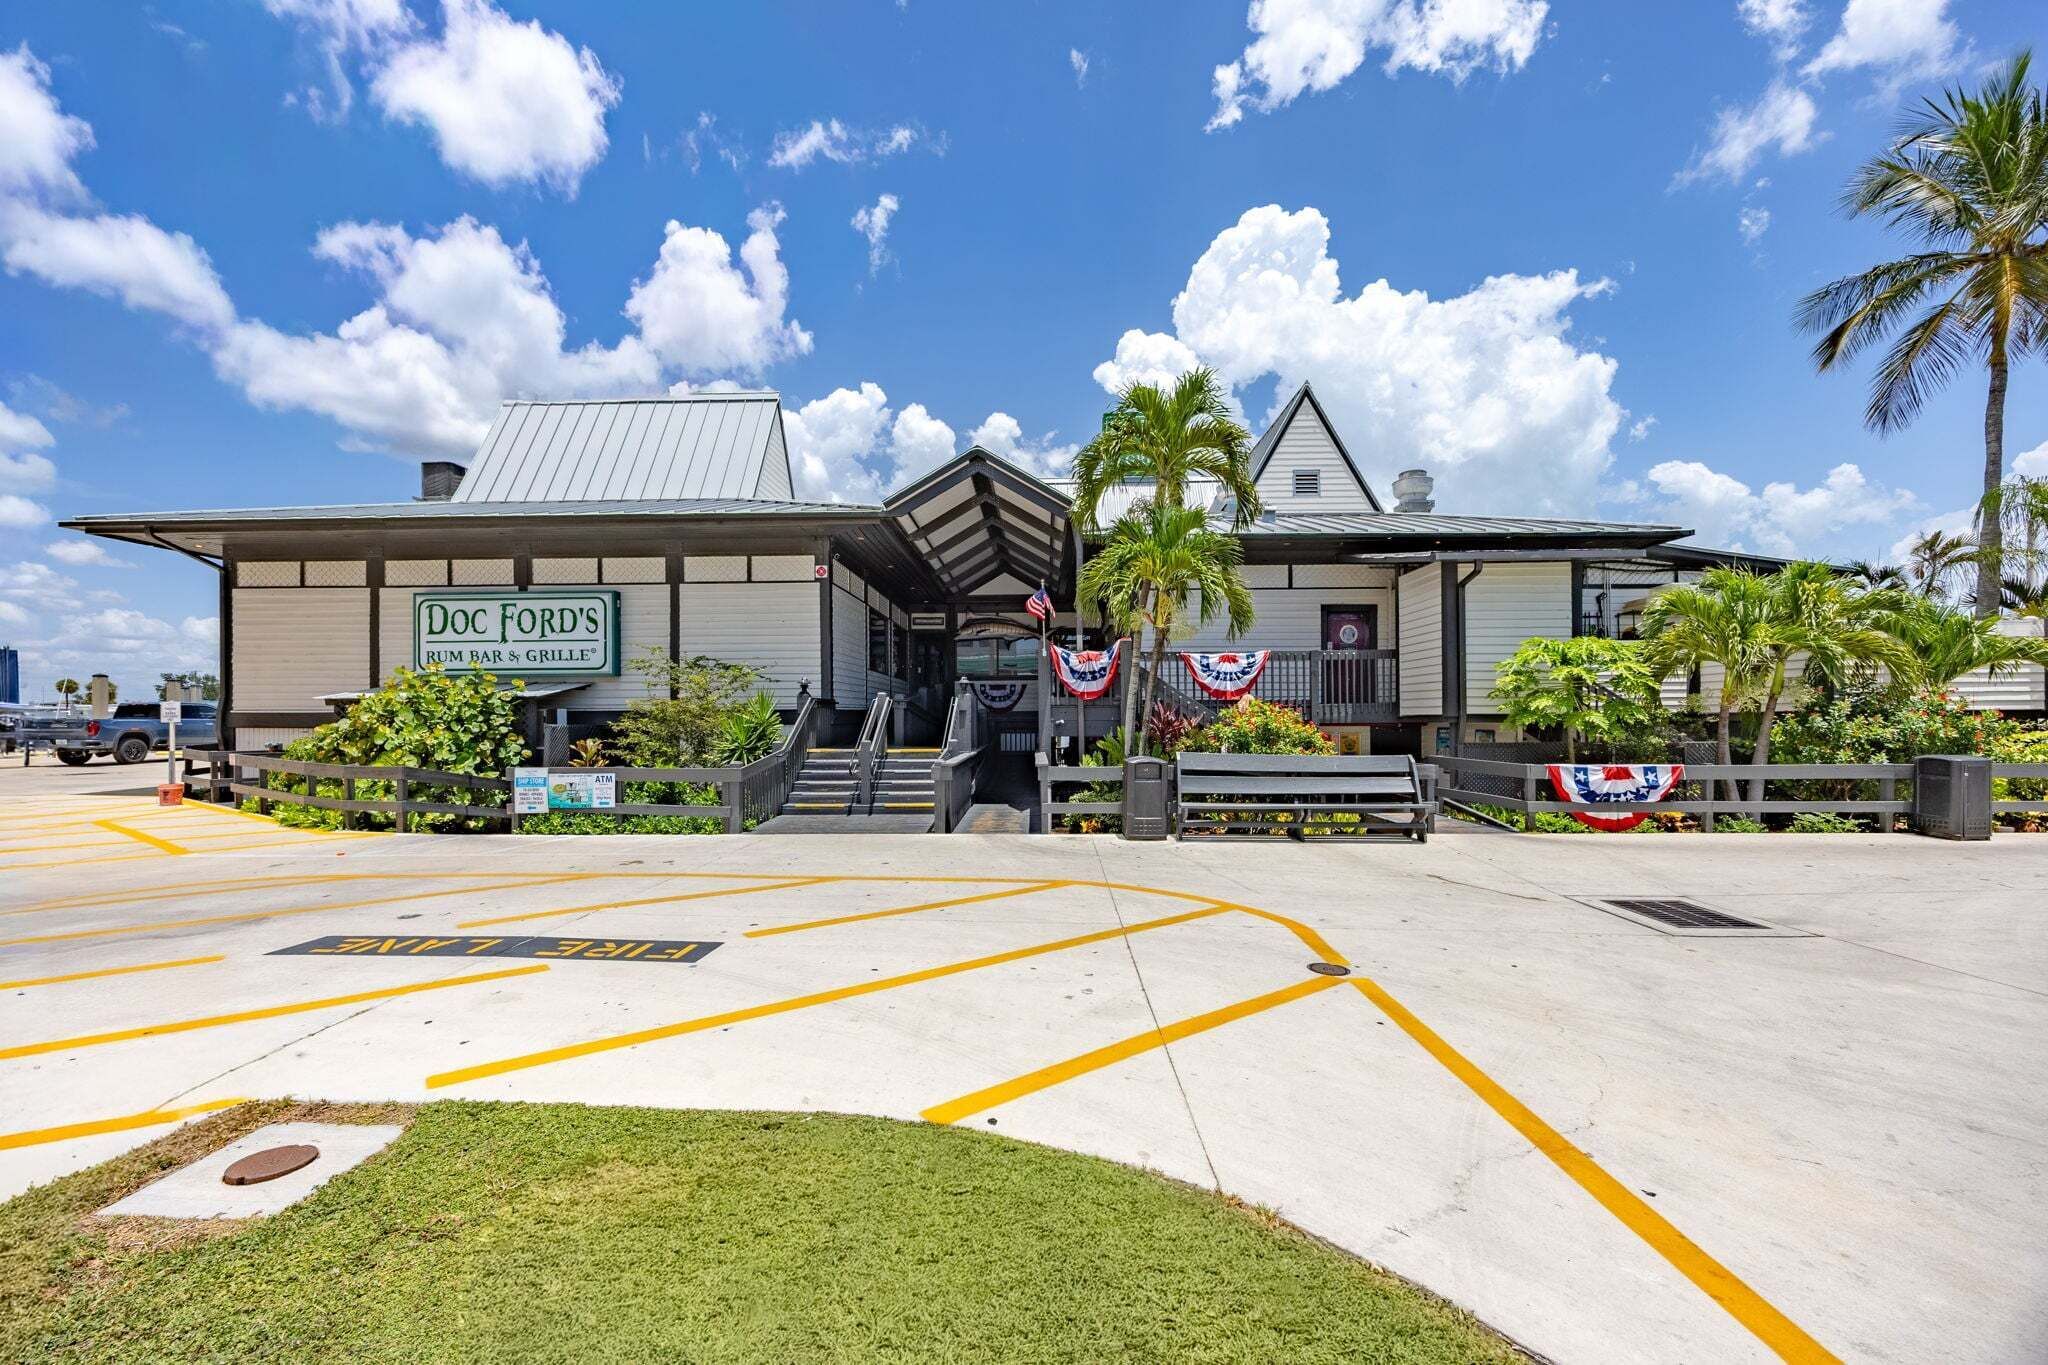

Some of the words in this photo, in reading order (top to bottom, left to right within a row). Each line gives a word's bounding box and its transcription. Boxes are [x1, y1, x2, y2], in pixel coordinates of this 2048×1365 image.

[426, 603, 488, 635] DOC
[498, 603, 599, 644] FORD'S
[426, 650, 464, 664] RUM
[470, 650, 503, 664] BAR
[508, 650, 521, 664] &
[595, 775, 613, 783] ATM
[309, 938, 504, 954] LANE
[534, 941, 699, 959] FIRE
